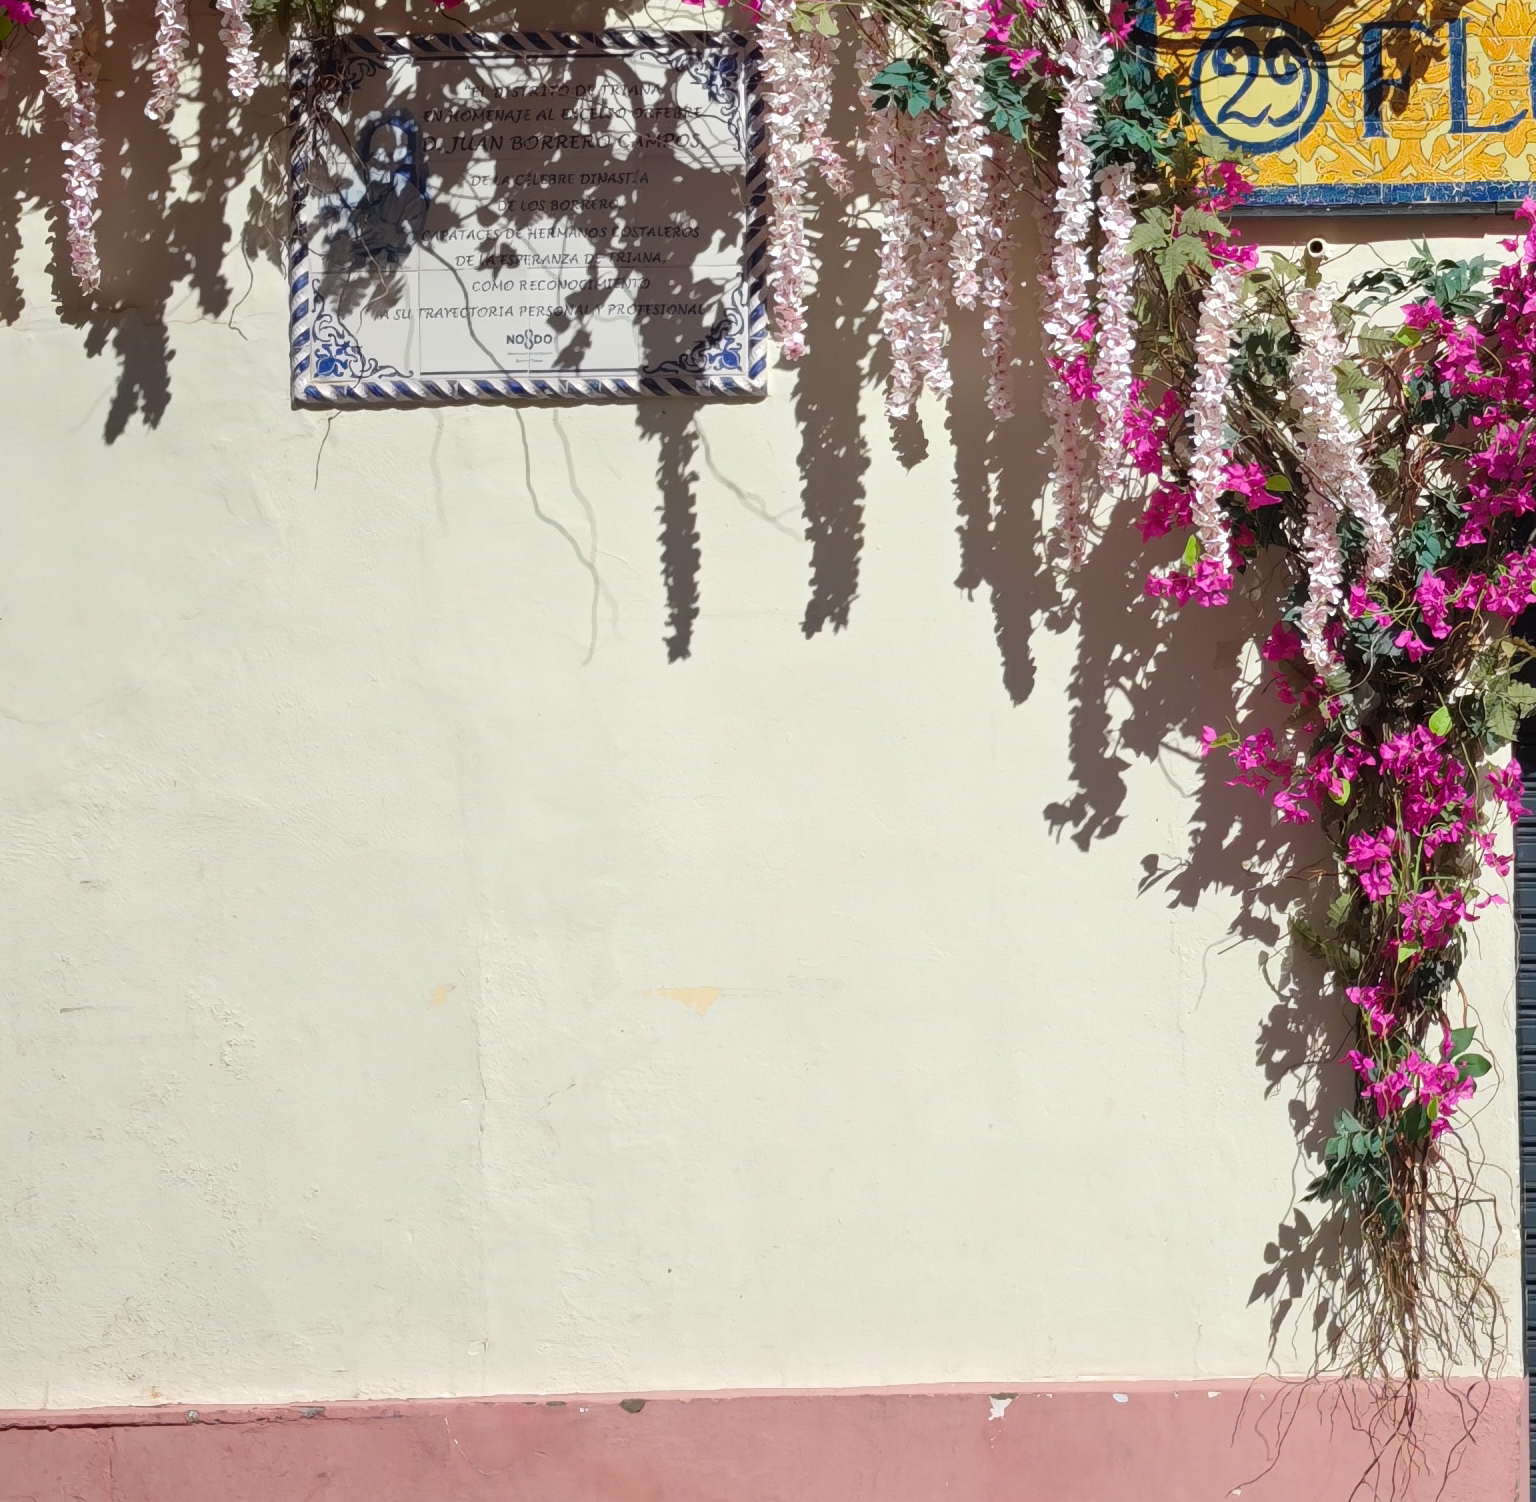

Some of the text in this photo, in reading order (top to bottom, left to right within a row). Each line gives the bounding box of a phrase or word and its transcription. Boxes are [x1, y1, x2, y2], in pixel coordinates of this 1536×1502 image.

[1210, 36, 1306, 125] 29
[576, 84, 594, 96] DE
[601, 84, 662, 96] TRIANA
[424, 108, 443, 122] EN
[446, 108, 531, 123] HOMENAJE
[536, 108, 555, 121] AL
[445, 135, 504, 154] JUAN
[510, 134, 611, 151] BORRERO
[471, 174, 490, 187] DE
[494, 174, 512, 185] LA
[498, 200, 516, 212] DE
[520, 199, 545, 212] LOS
[421, 226, 699, 242] CAPATACES DE HERMANOS COSTALEROS
[455, 254, 475, 267] DE
[480, 254, 495, 266] LA
[500, 253, 578, 266] ESPERANZA
[584, 253, 602, 265] DE
[472, 277, 650, 291] COMO RECONOCIMIENTO
[393, 309, 412, 321] SU
[418, 306, 514, 320] TRAYECTORIA
[518, 304, 590, 317] PERSONAL
